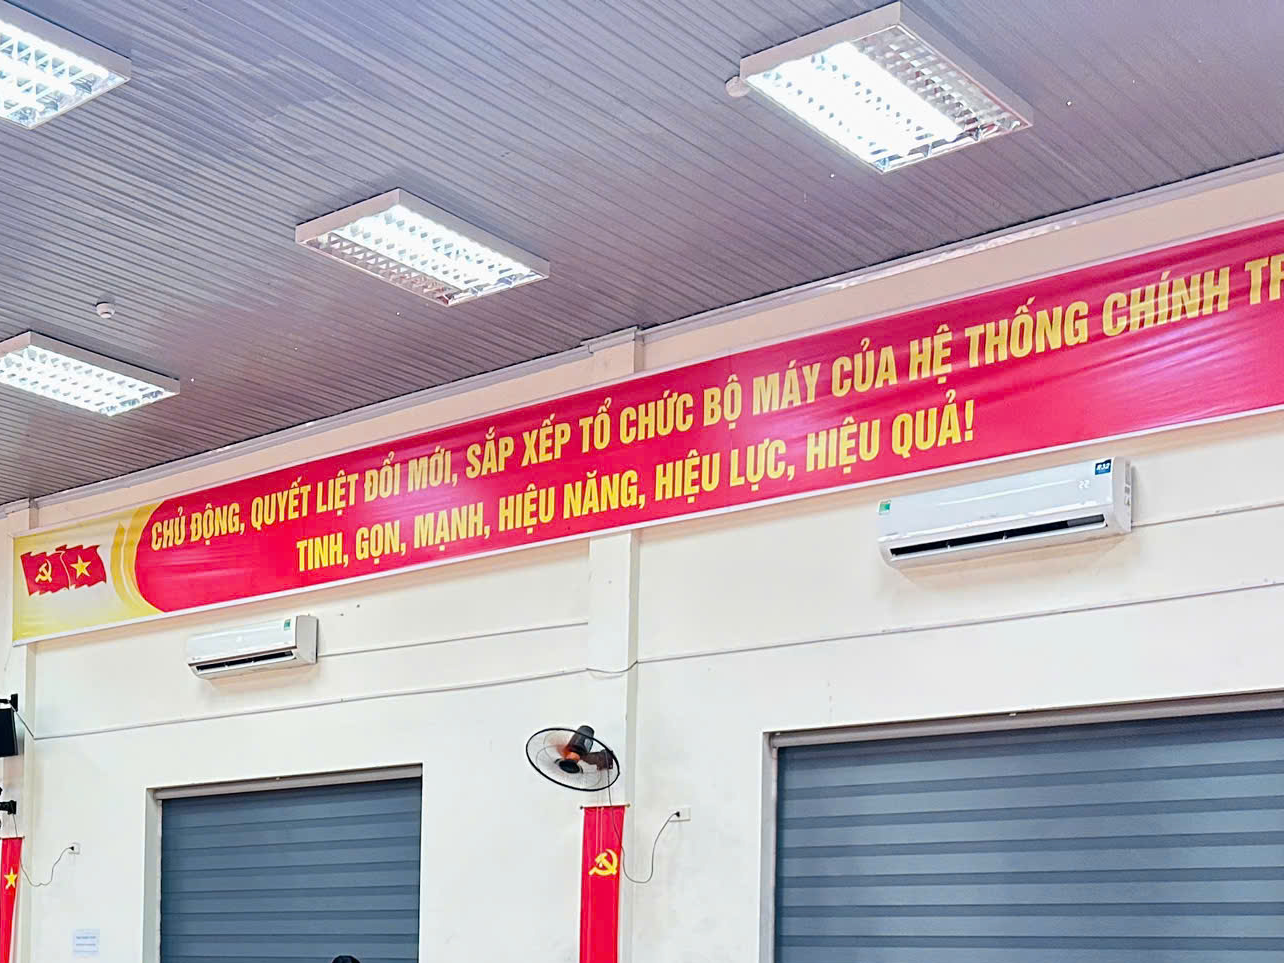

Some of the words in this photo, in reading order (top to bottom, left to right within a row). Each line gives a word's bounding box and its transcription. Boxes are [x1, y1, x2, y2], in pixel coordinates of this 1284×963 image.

[151, 506, 186, 551] CHỦ
[190, 503, 244, 545] ĐỘNG,
[251, 477, 311, 530] QUYẾT
[317, 470, 358, 516] LIỆT
[364, 452, 401, 502] ĐỔI
[407, 446, 457, 494] MỚI,
[466, 427, 514, 478] SẮP
[522, 414, 570, 466] XẾP
[579, 398, 611, 453] TỔ
[620, 390, 693, 444] CHỨC
[704, 374, 742, 430] BỘ
[752, 360, 820, 416] MÁY
[832, 338, 898, 397] CỦA
[909, 324, 953, 384] HỆ
[965, 296, 1088, 368] THỐNG
[1102, 267, 1230, 337] CHÍNH
[297, 536, 348, 572] TINH,
[356, 520, 406, 564] GỌN,
[414, 502, 490, 551] MẠNH,
[499, 484, 554, 534] HIỆU
[564, 470, 645, 519] NĂNG,
[655, 449, 720, 503] HIỆU
[730, 438, 795, 491] LỰC,
[805, 417, 880, 474] HIỆU
[892, 389, 975, 458] QUẢ!
